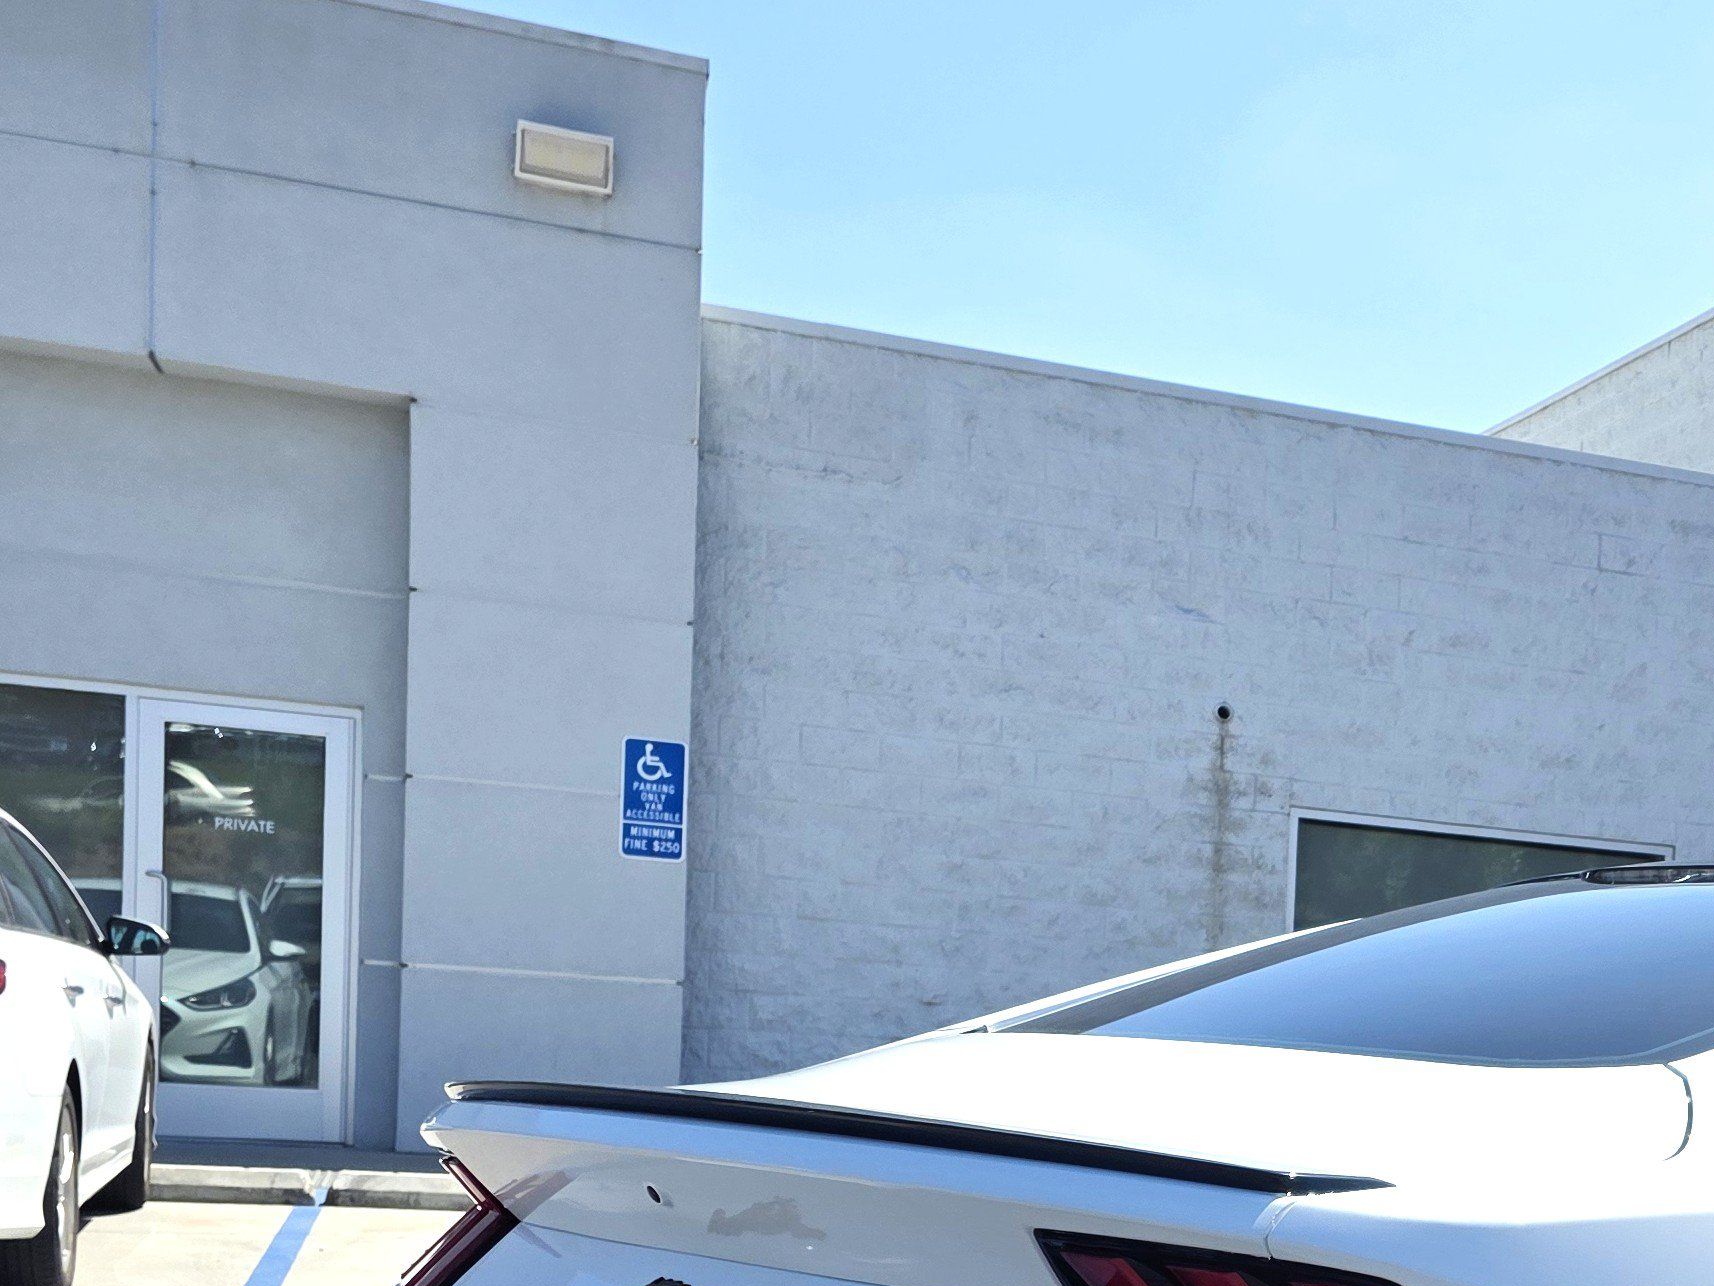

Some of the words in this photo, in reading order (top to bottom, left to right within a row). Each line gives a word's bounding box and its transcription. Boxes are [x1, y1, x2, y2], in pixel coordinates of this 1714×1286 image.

[633, 781, 676, 795] PARKING
[641, 792, 666, 803] ONLY
[625, 809, 680, 823] ACCESSIBLE
[214, 816, 275, 835] PRIVATE
[630, 826, 676, 840] MINIMUM
[624, 838, 648, 851] FINE
[653, 841, 680, 854] $250
